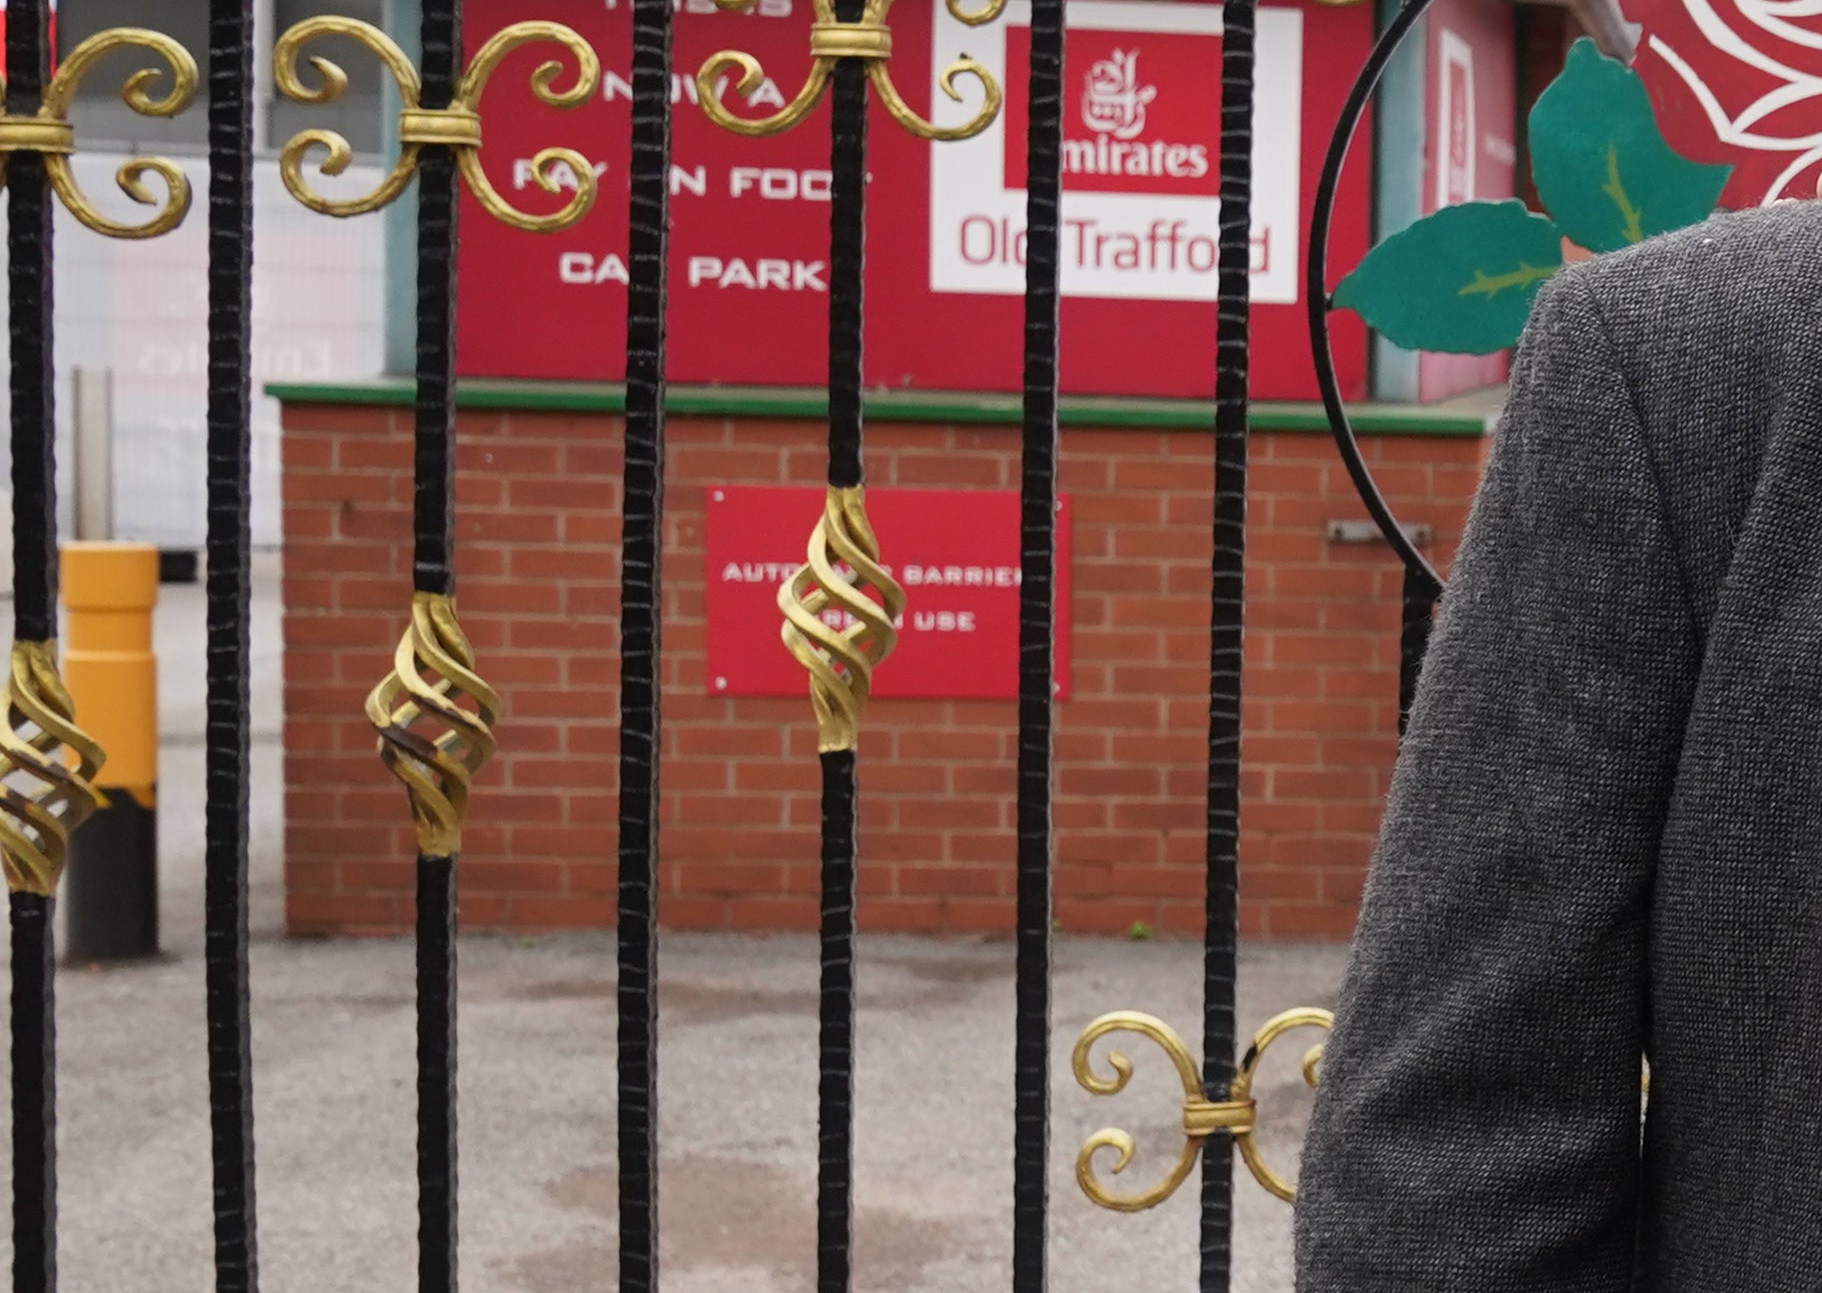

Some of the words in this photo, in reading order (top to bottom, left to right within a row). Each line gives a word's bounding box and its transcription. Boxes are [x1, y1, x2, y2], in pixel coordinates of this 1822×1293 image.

[603, 70, 730, 105] NW
[1062, 134, 1209, 178] mirates
[730, 167, 873, 202] FOO
[1064, 217, 1271, 274] Traffod
[559, 252, 631, 285] CA
[688, 256, 827, 291] PARK
[913, 611, 976, 632] USE
